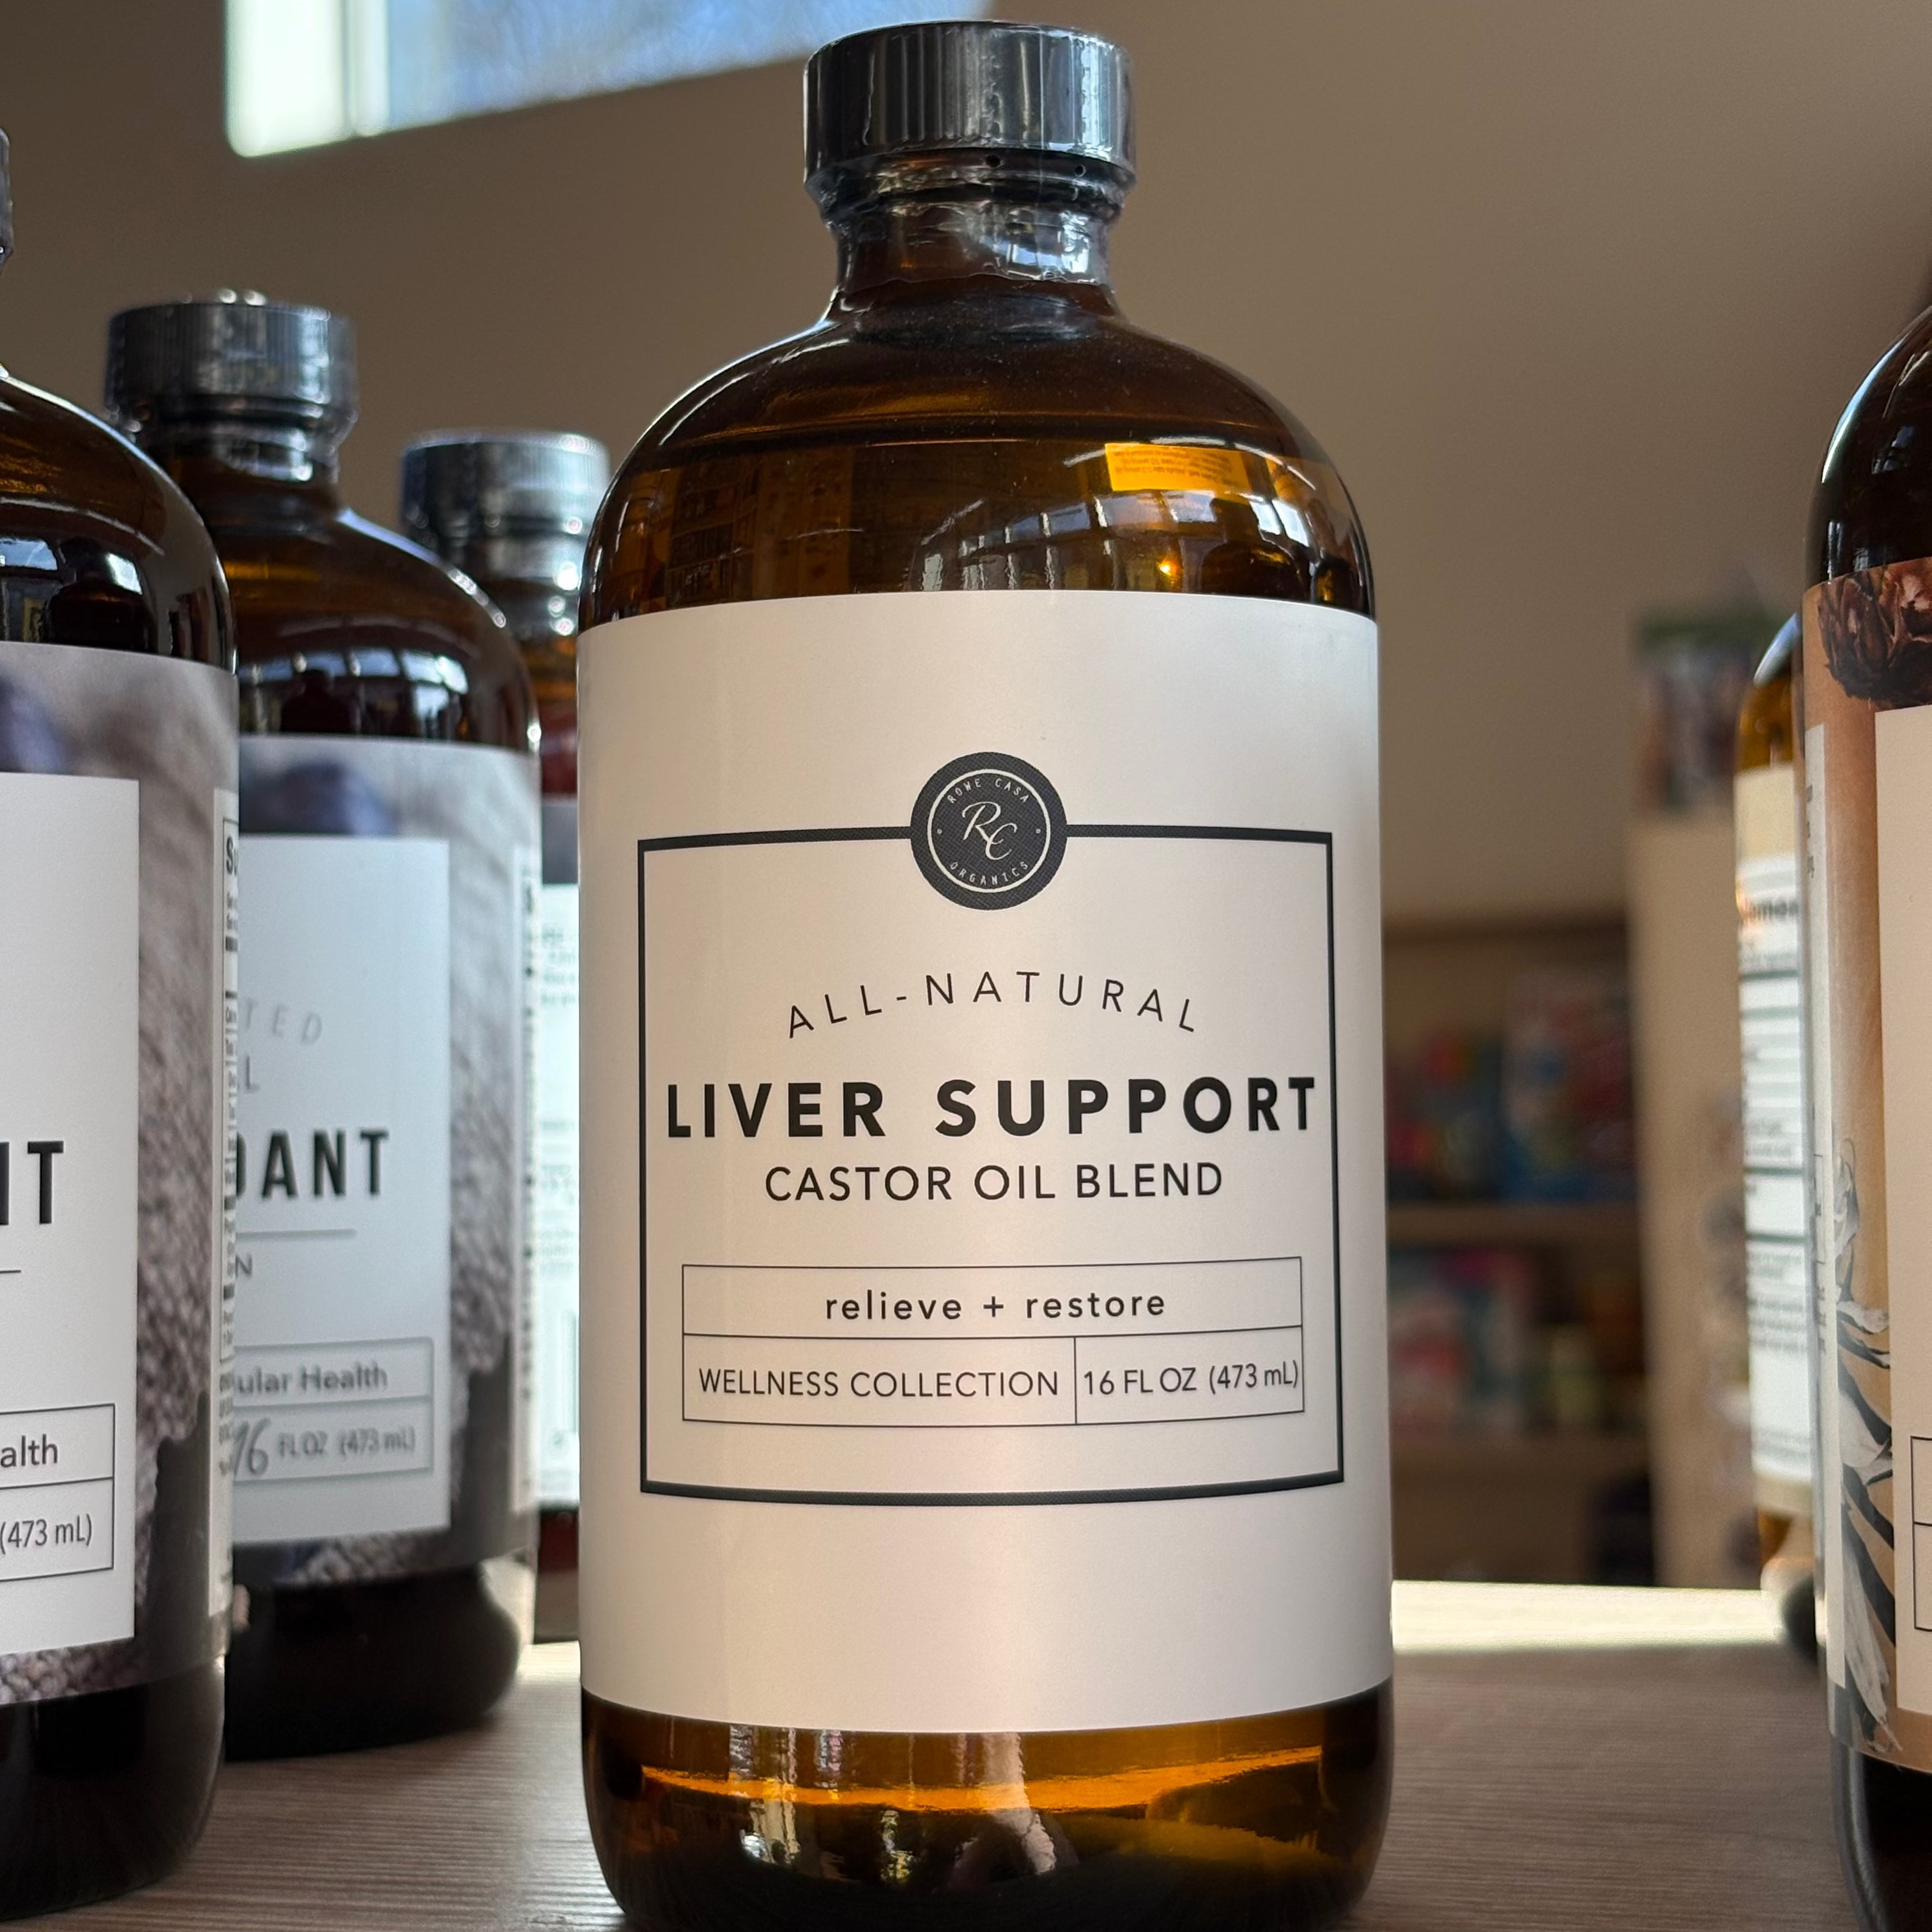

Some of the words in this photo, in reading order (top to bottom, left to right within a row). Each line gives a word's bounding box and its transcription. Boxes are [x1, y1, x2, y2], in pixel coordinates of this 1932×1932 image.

[947, 778, 981, 804] ROWE
[995, 778, 1031, 803] CASA
[949, 861, 1029, 886] ORGANICS
[789, 971, 1194, 1039] ALL-NATURAL
[668, 1081, 886, 1138] LIVER
[935, 1077, 1315, 1137] SUPPORT
[765, 1166, 952, 1201] CASTOR
[974, 1165, 1055, 1200] OIL
[1077, 1162, 1222, 1199] BLEND
[825, 1289, 962, 1320] relieve
[983, 1296, 1004, 1318] +
[1026, 1292, 1165, 1319] restore
[298, 1360, 388, 1393] Health
[698, 1368, 839, 1397] WELLNESS
[850, 1370, 1058, 1397] COLLECTION
[1084, 1369, 1115, 1395] 16
[1124, 1369, 1154, 1394] FL
[1160, 1367, 1198, 1393] OZ
[1209, 1363, 1258, 1395] (473
[1264, 1360, 1299, 1389] mL)
[0, 1518, 47, 1556] (473
[55, 1513, 93, 1549] mL)
